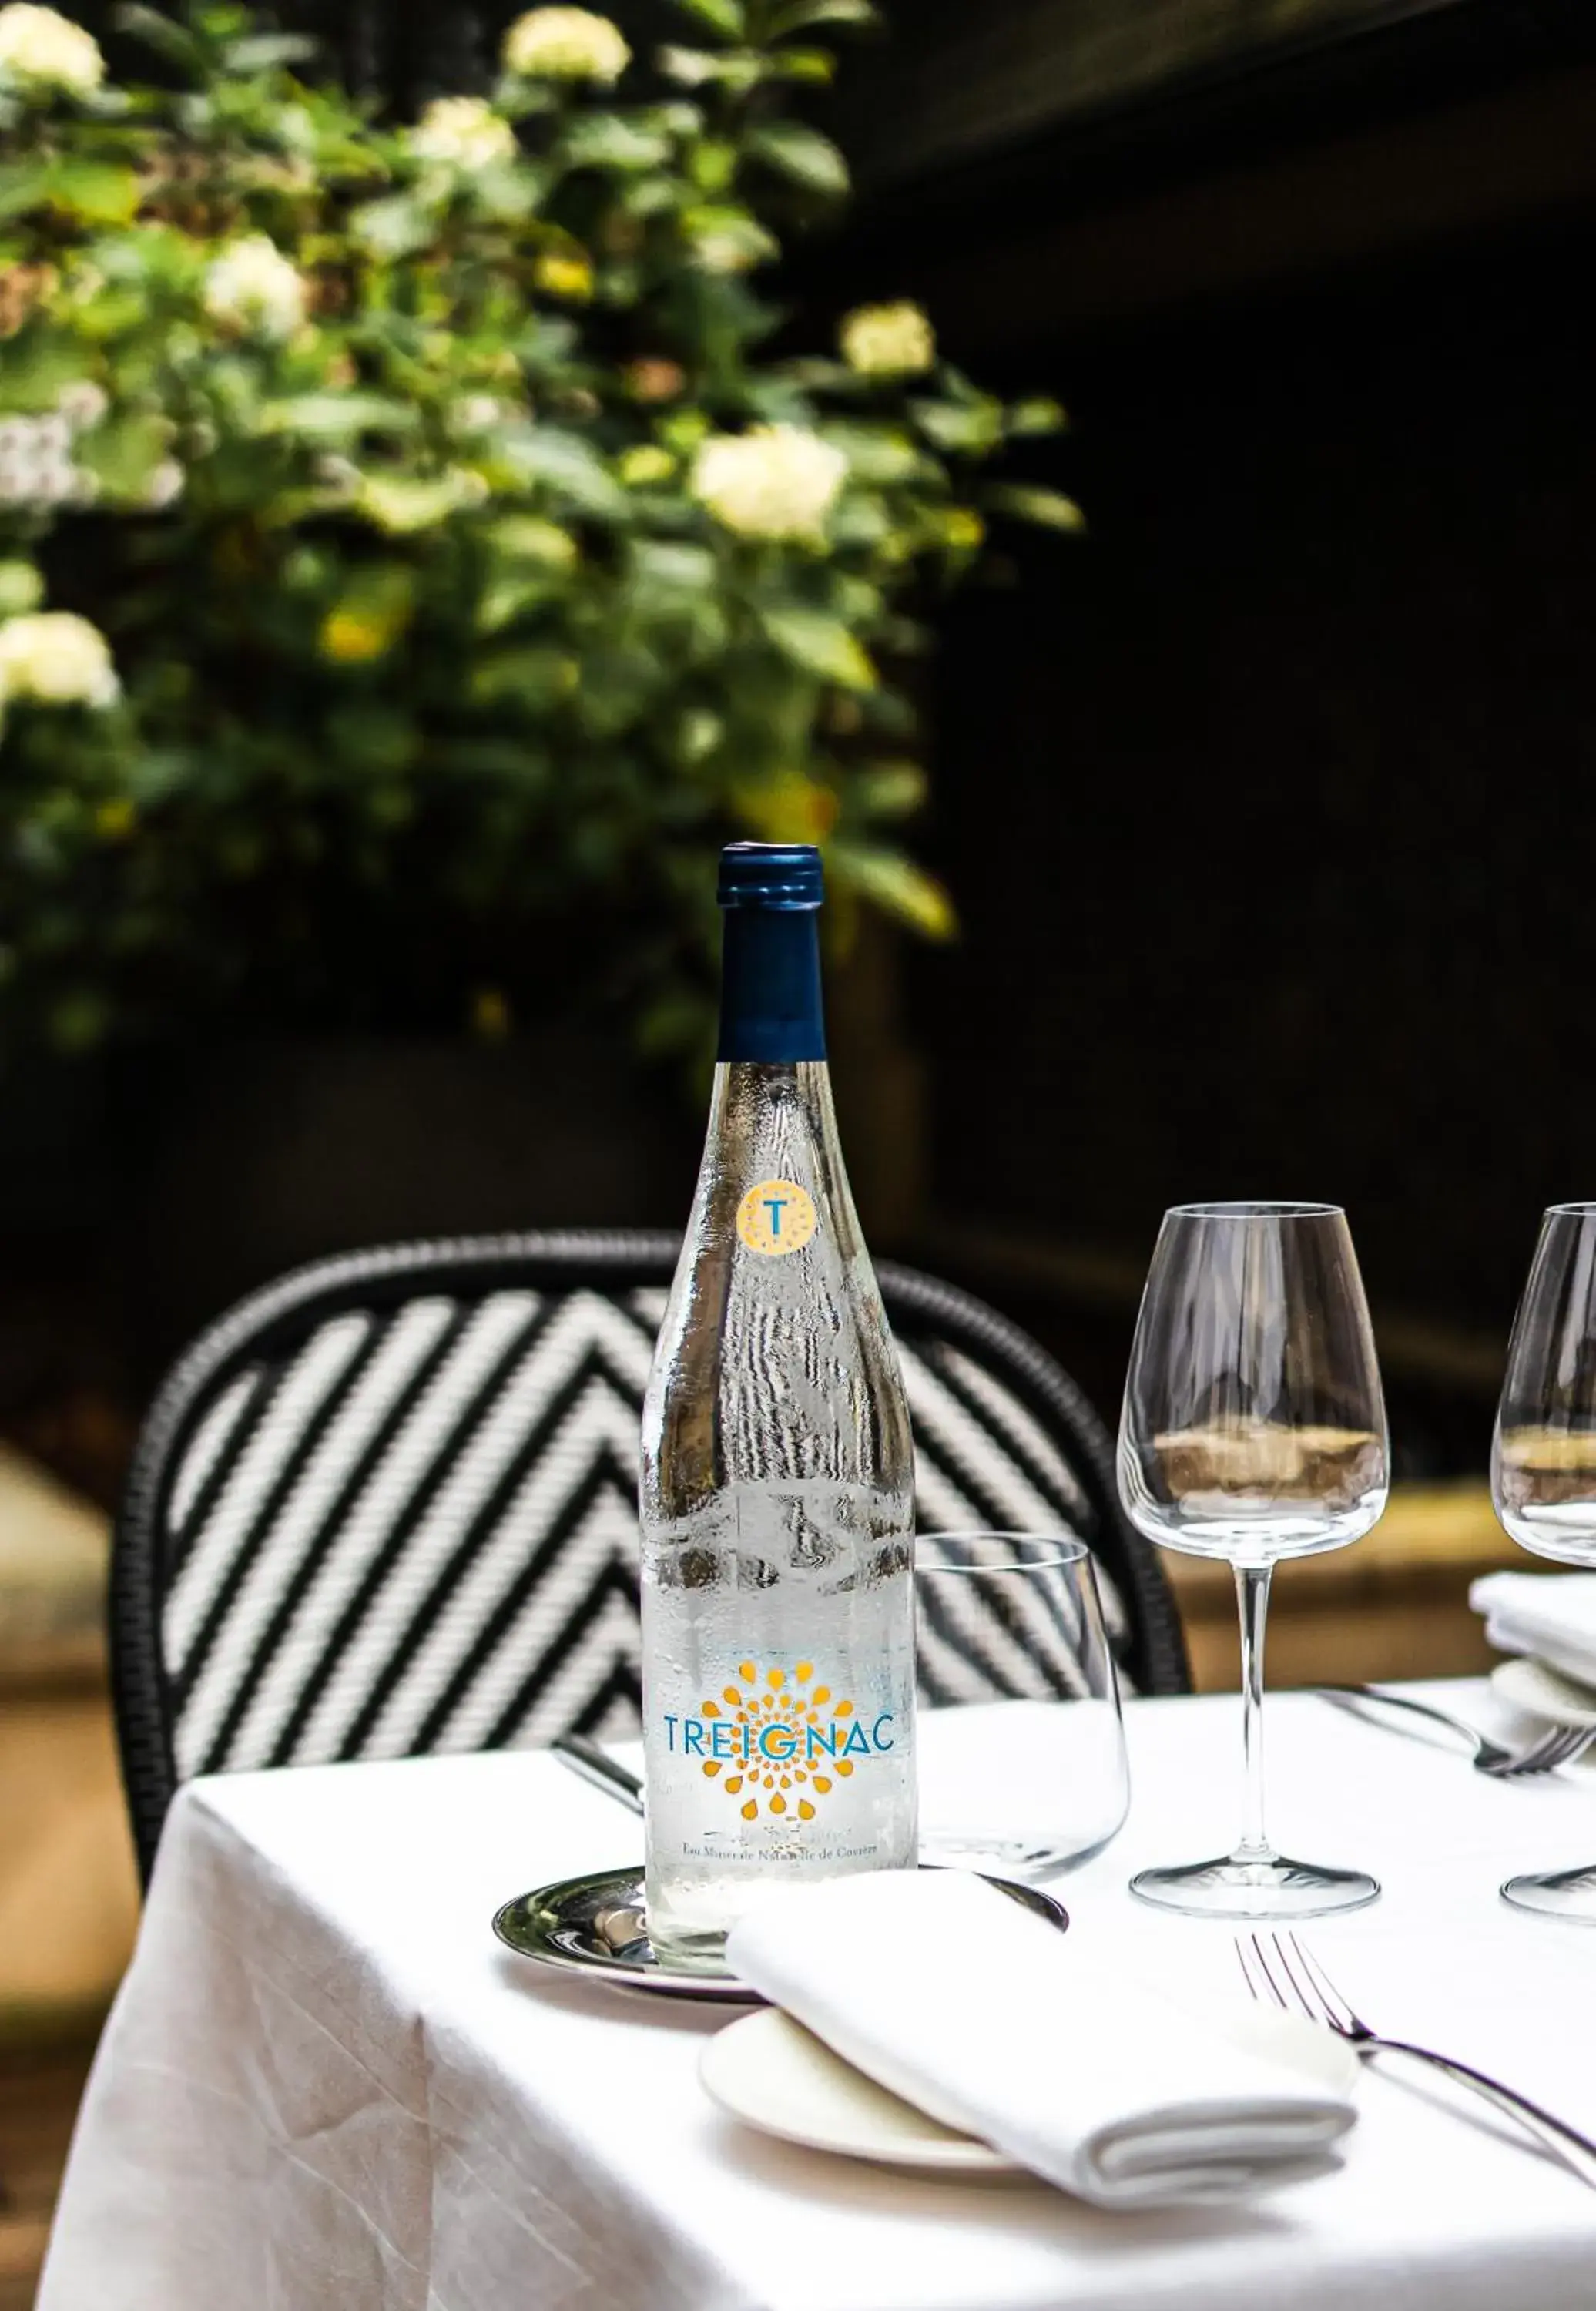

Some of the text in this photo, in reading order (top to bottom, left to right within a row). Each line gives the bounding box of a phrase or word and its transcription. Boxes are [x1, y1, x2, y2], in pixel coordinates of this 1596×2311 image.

[763, 1199, 787, 1235] T
[664, 1715, 894, 1760] TREIGNAC
[818, 1848, 833, 1860] de
